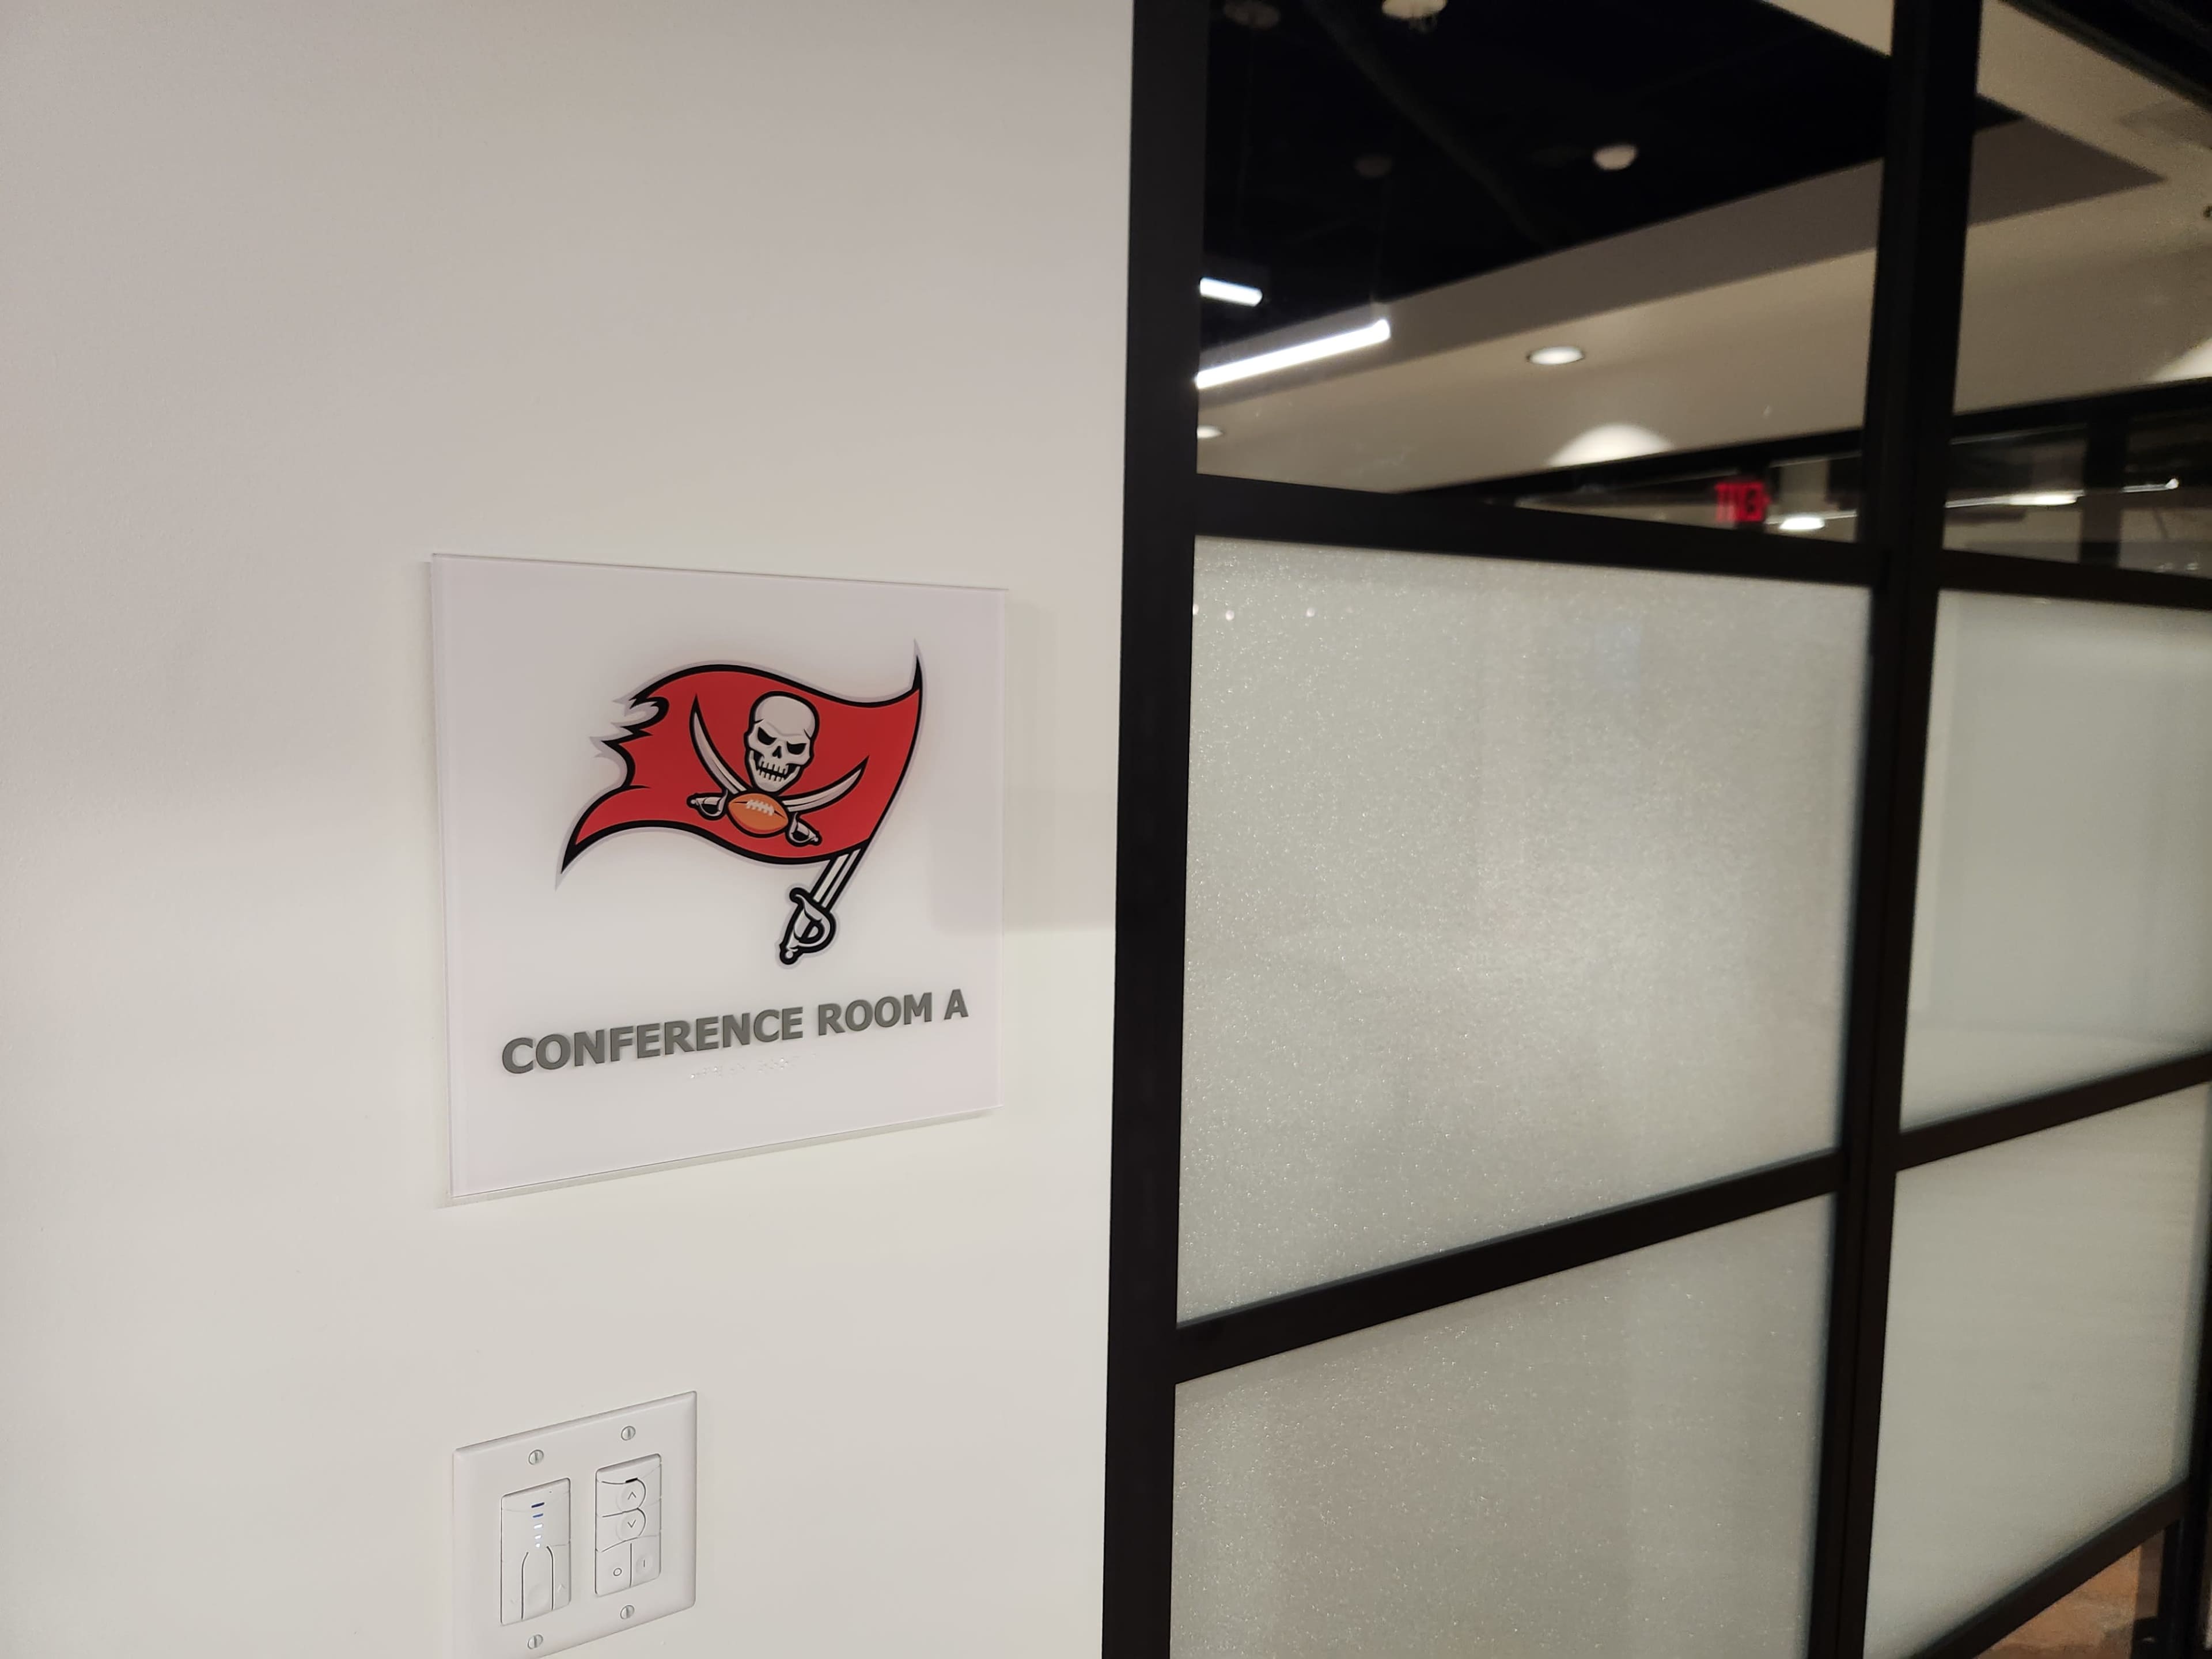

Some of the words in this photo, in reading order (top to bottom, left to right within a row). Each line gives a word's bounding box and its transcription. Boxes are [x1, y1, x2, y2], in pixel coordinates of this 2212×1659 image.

[502, 1006, 804, 1074] CONFERENCE
[817, 991, 933, 1036] ROOM
[944, 988, 969, 1021] A
